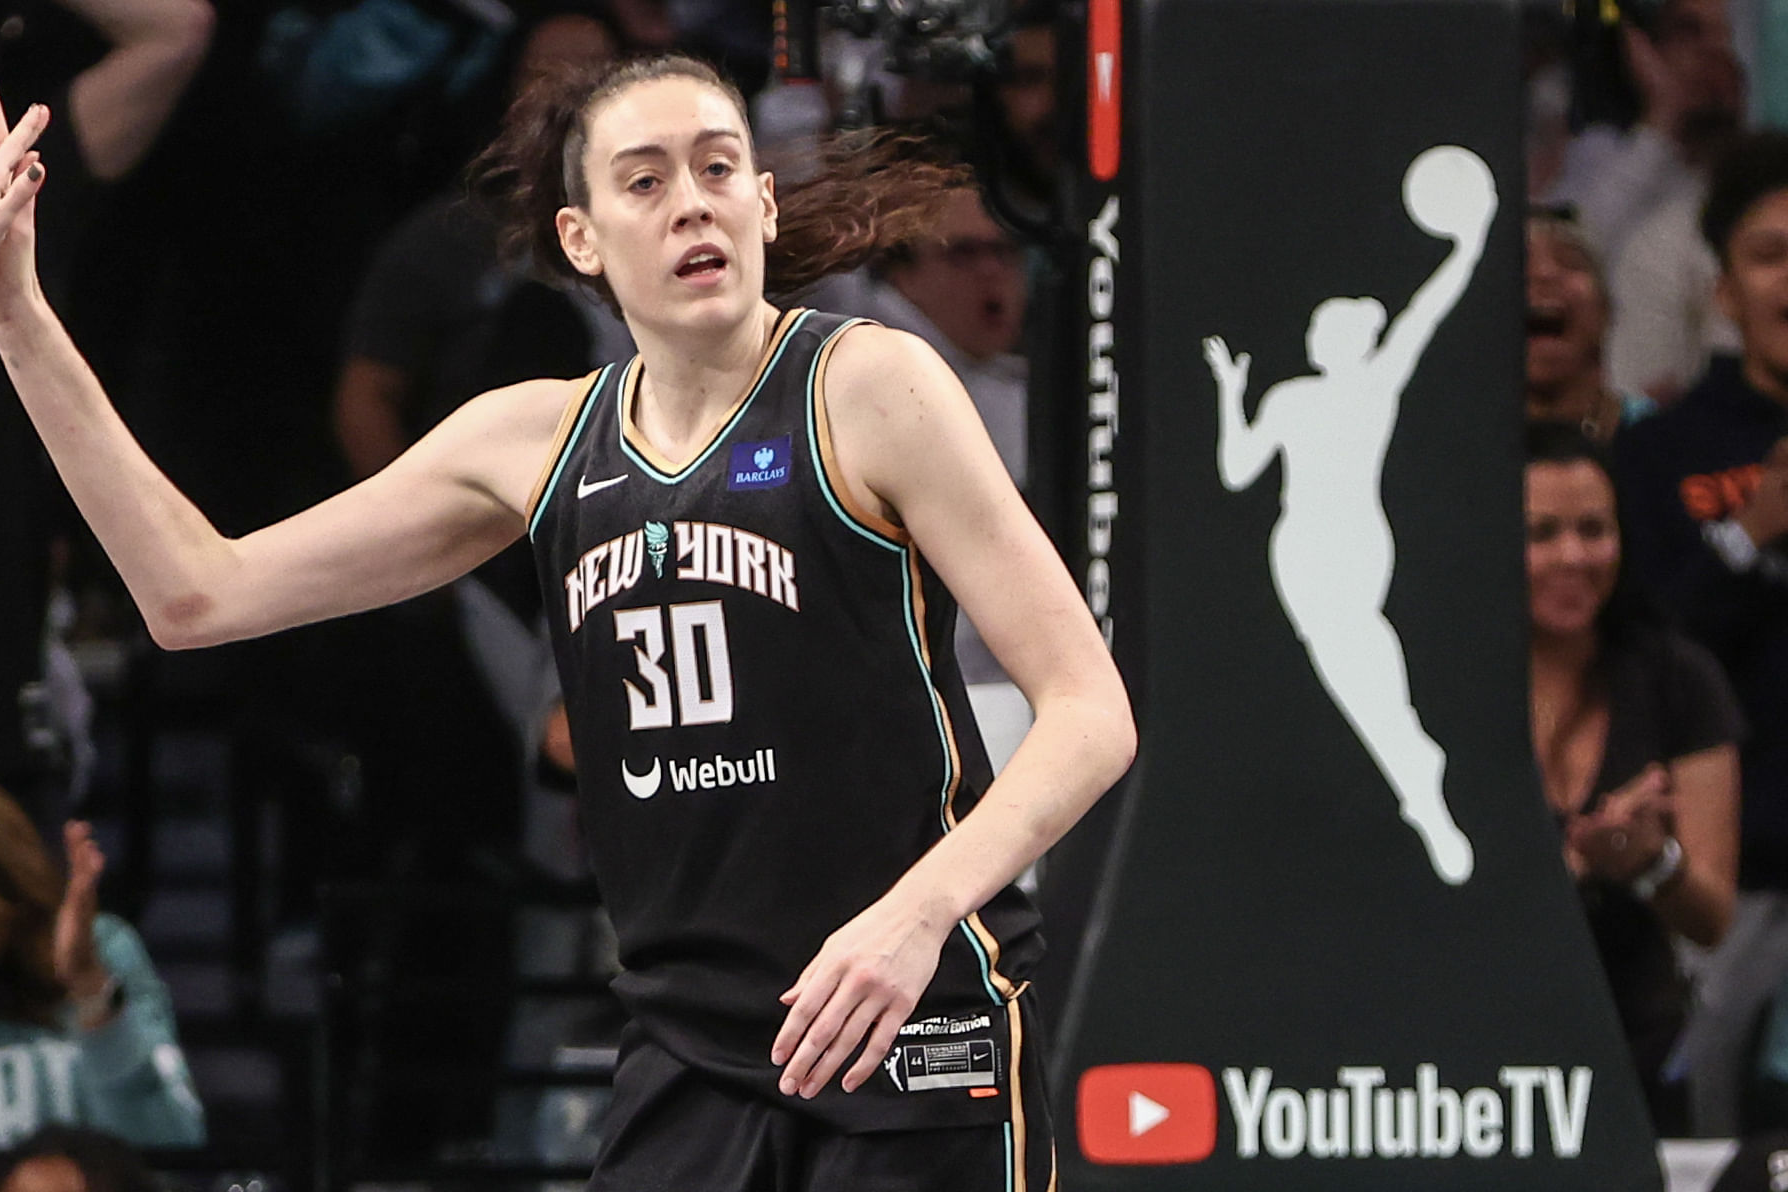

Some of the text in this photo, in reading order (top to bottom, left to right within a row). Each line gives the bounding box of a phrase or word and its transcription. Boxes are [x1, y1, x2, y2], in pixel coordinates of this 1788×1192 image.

[735, 466, 787, 484] BARCLAYS
[564, 520, 801, 634] NEW YORK
[613, 600, 734, 731] 30
[669, 749, 776, 792] Webull
[949, 1015, 991, 1035] EDITION
